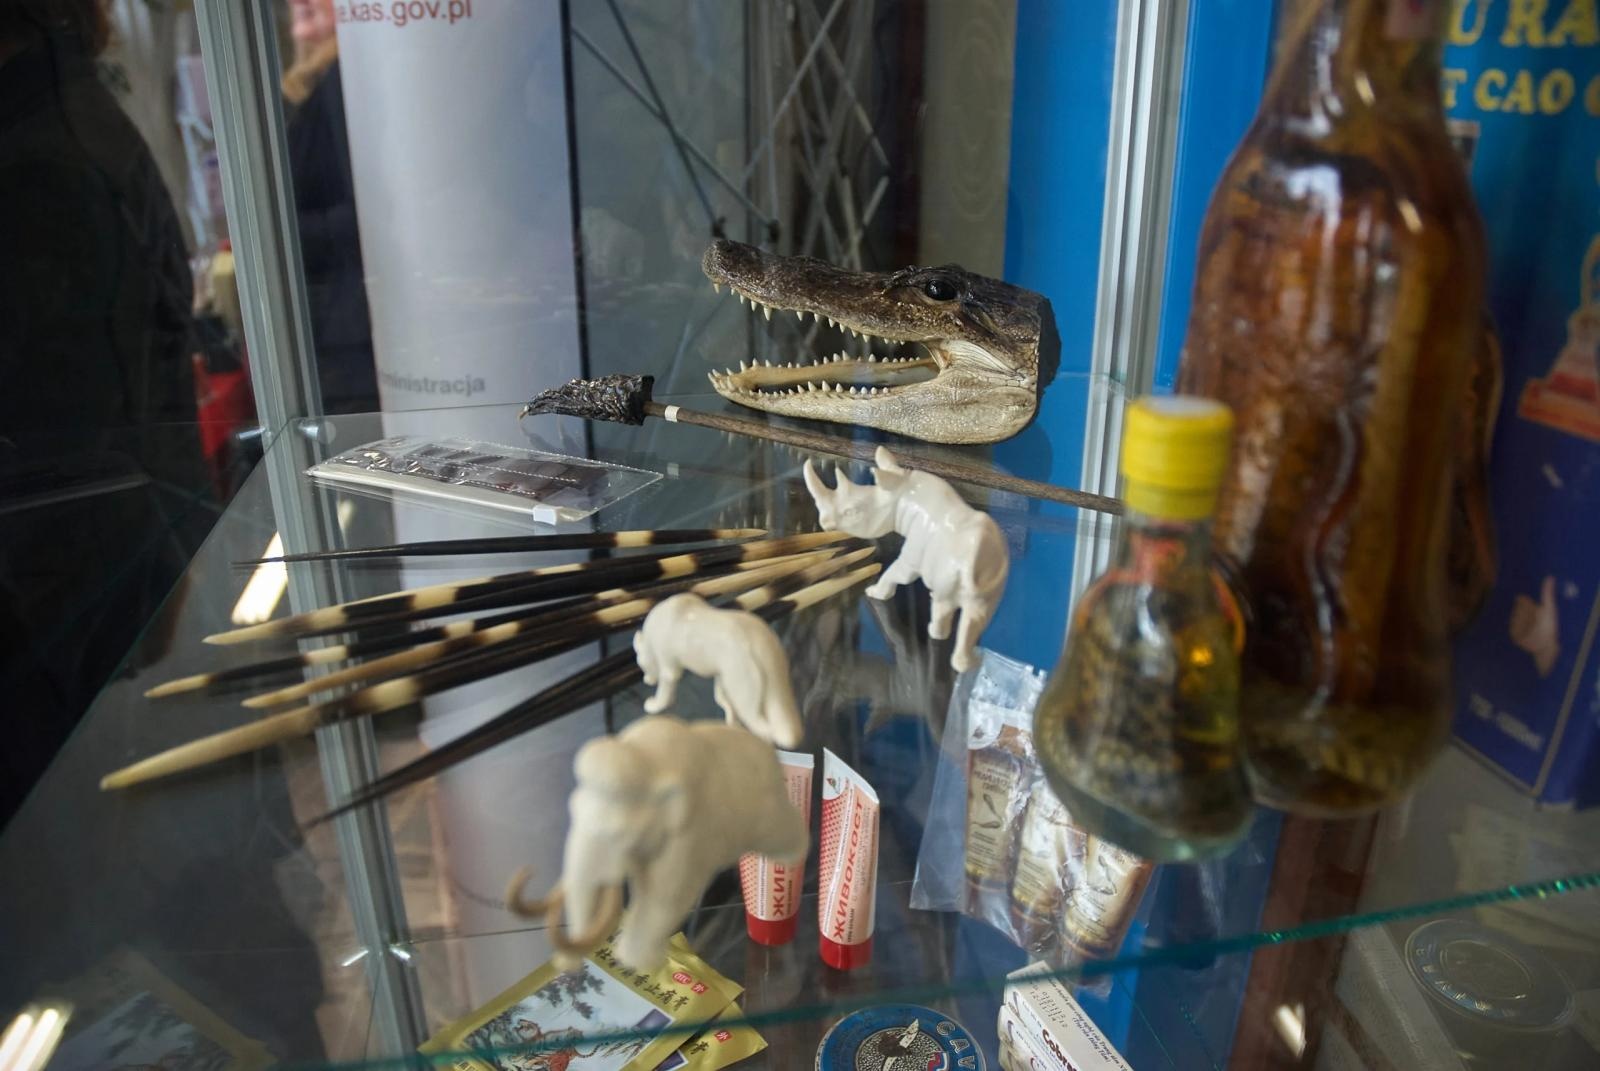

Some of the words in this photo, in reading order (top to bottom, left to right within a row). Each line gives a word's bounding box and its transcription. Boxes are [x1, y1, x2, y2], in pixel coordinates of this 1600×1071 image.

[1474, 68, 1575, 114] CAO
[833, 796, 864, 942] ЖИВОКОСТ
[936, 1020, 976, 1071] CAV
